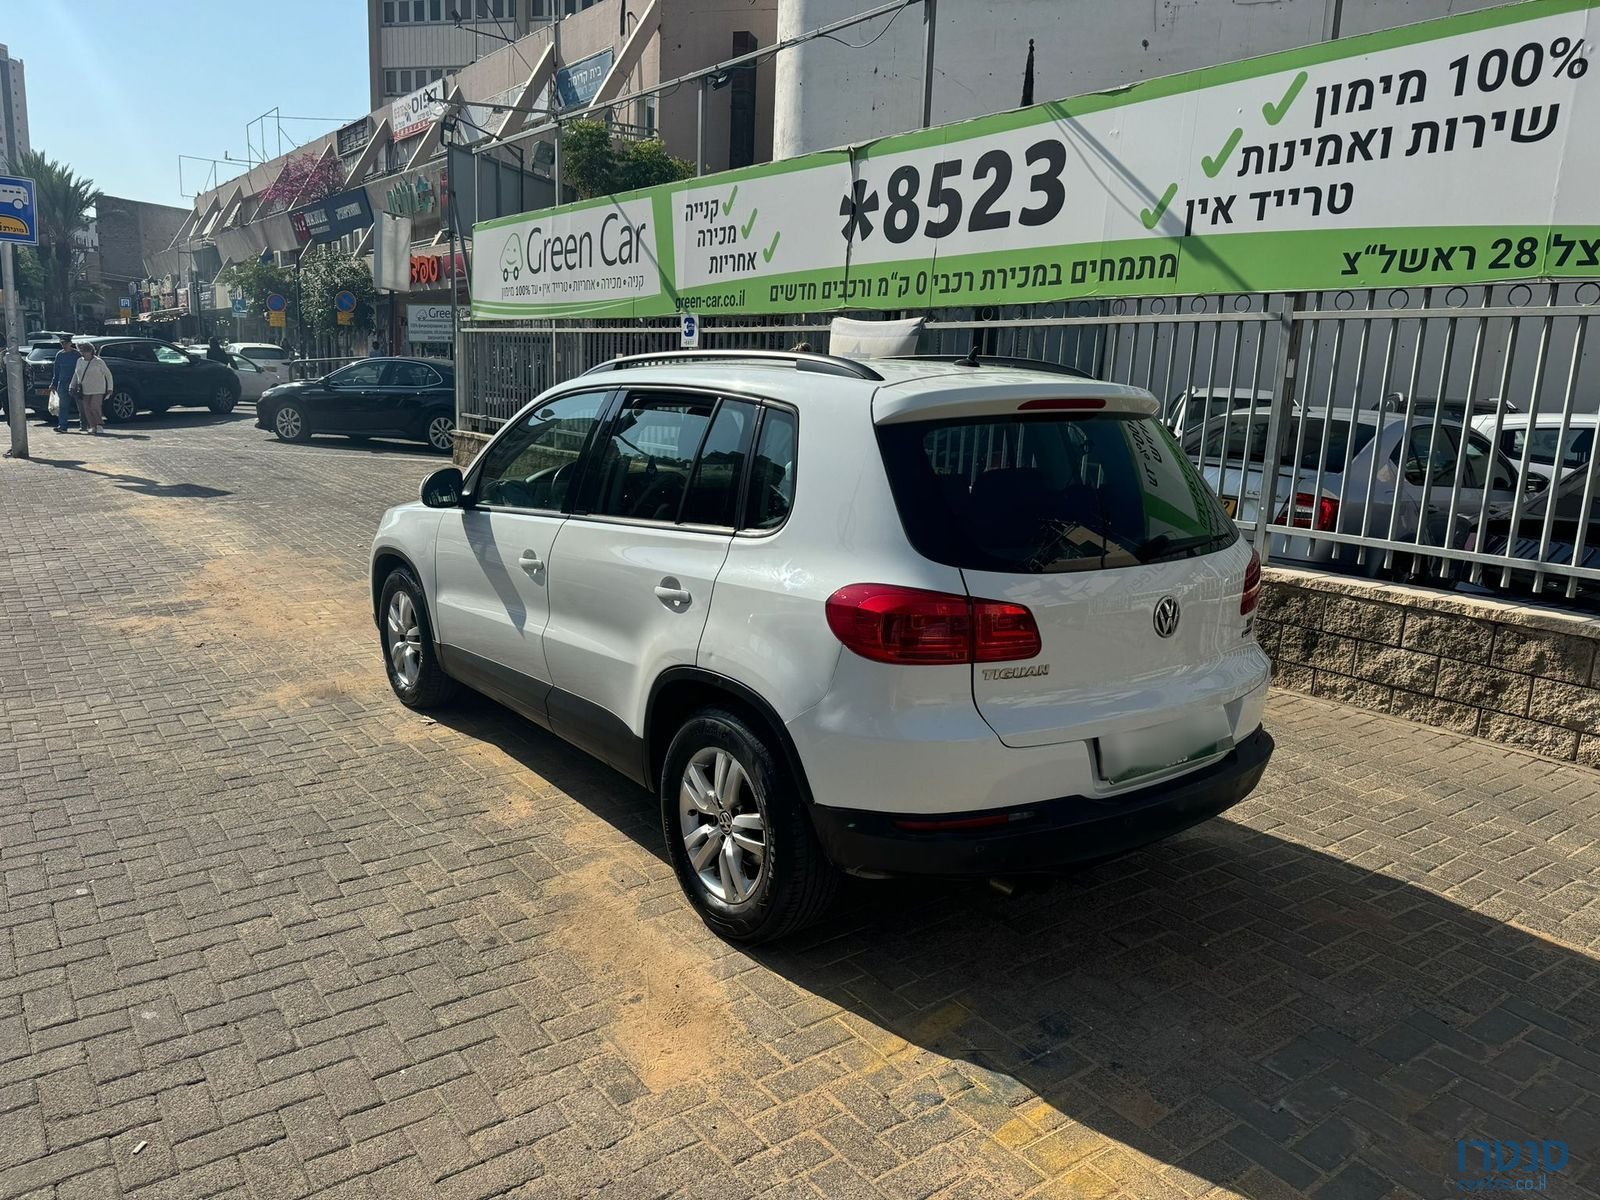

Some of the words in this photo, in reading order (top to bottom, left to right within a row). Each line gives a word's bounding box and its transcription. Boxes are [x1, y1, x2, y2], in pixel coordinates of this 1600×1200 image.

[1449, 36, 1589, 97] 100%
[1313, 69, 1427, 128] מימון
[1405, 103, 1560, 157] שירות
[1237, 126, 1393, 177] ואמינות
[685, 198, 719, 224] קנייה
[1249, 181, 1354, 221] טרייד
[1184, 194, 1237, 237] אין
[526, 227, 593, 275] Green
[600, 212, 647, 267] Car
[697, 224, 737, 247] מכירה
[708, 251, 758, 274] אחריות
[1341, 243, 1477, 276] ראשל"צ
[1487, 236, 1539, 270] 28
[979, 263, 1063, 291] במכירת
[1070, 253, 1177, 284] מתמחים
[515, 285, 531, 296] 100%
[551, 281, 568, 293] טרייד
[572, 279, 596, 292] אחריות
[600, 277, 622, 290] מכירה
[627, 275, 644, 291] קניה
[769, 282, 817, 302] חדשים
[821, 278, 872, 300] ורכבים
[877, 271, 909, 297] ק"מ
[916, 270, 928, 295] 0
[932, 270, 974, 294] רכבי
[675, 289, 745, 312] green-car.co.il
[982, 664, 1050, 681] TIGUAN
